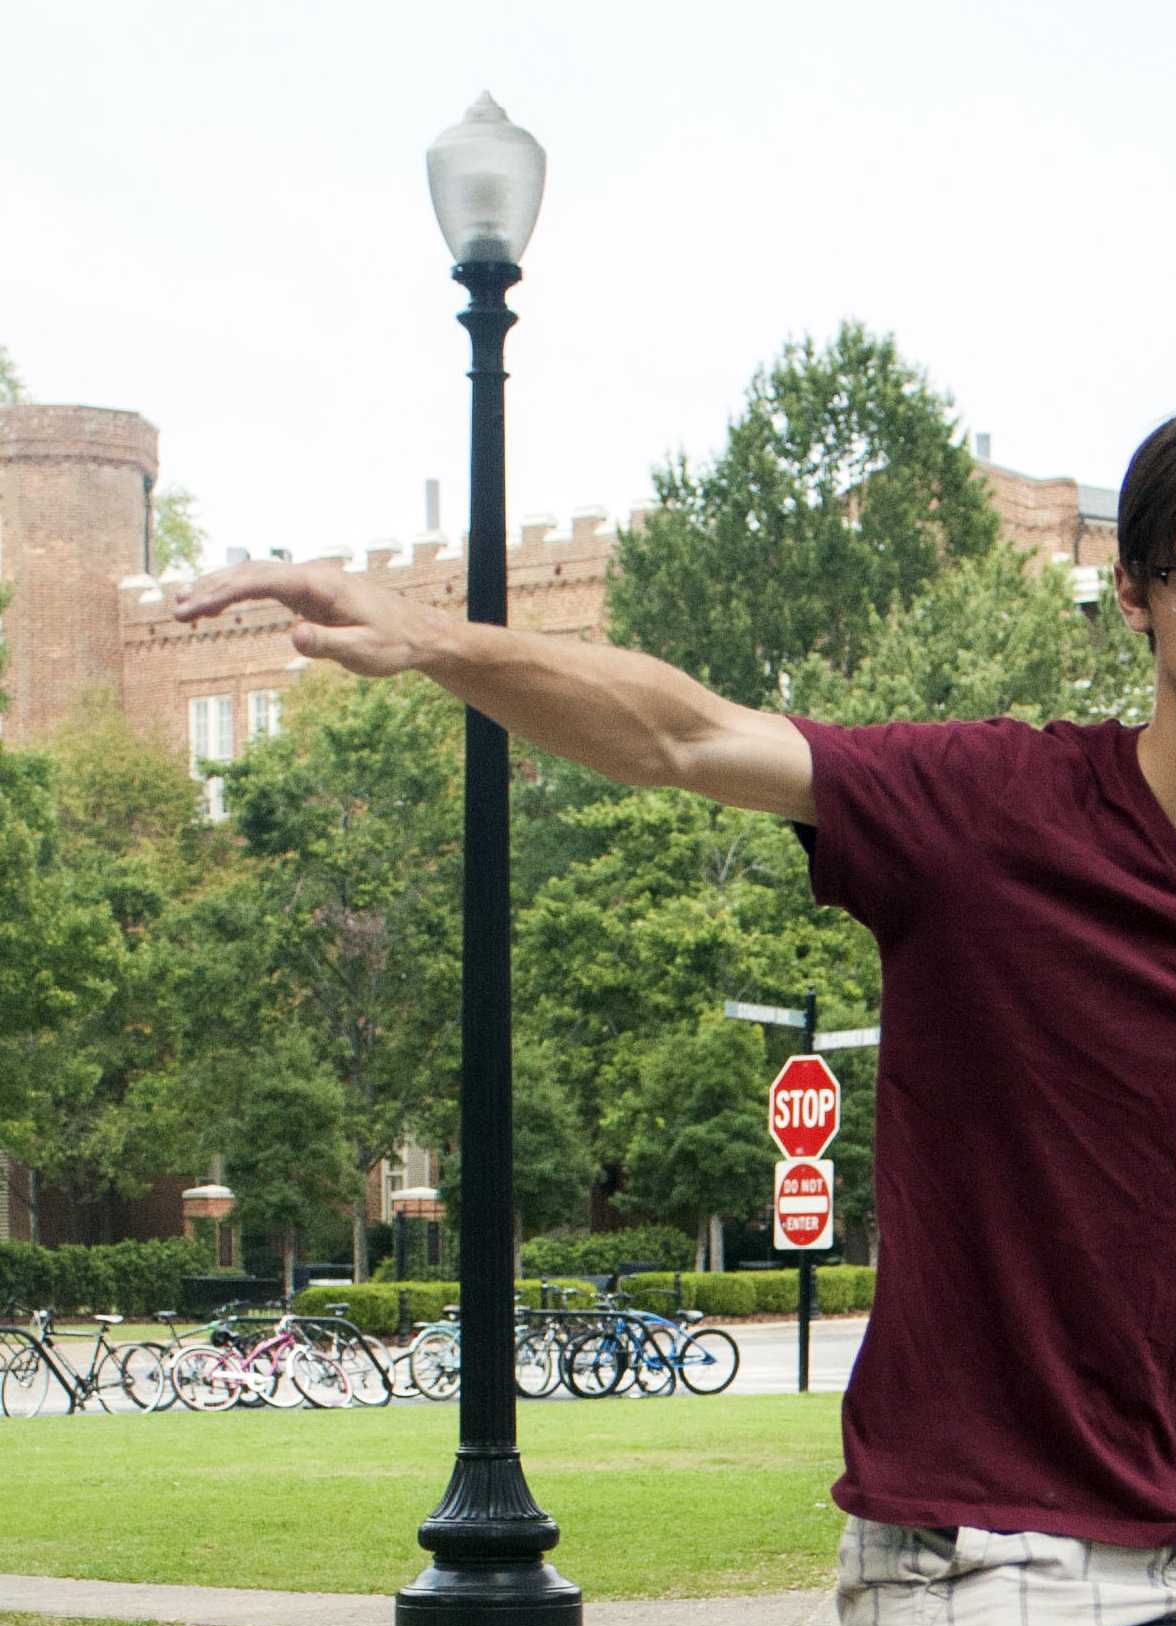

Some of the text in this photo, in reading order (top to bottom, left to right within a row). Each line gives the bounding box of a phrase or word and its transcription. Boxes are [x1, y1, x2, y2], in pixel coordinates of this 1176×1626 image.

[775, 1088, 835, 1129] STOP
[783, 1178, 823, 1194] DO NOT
[786, 1216, 819, 1231] ENTER
